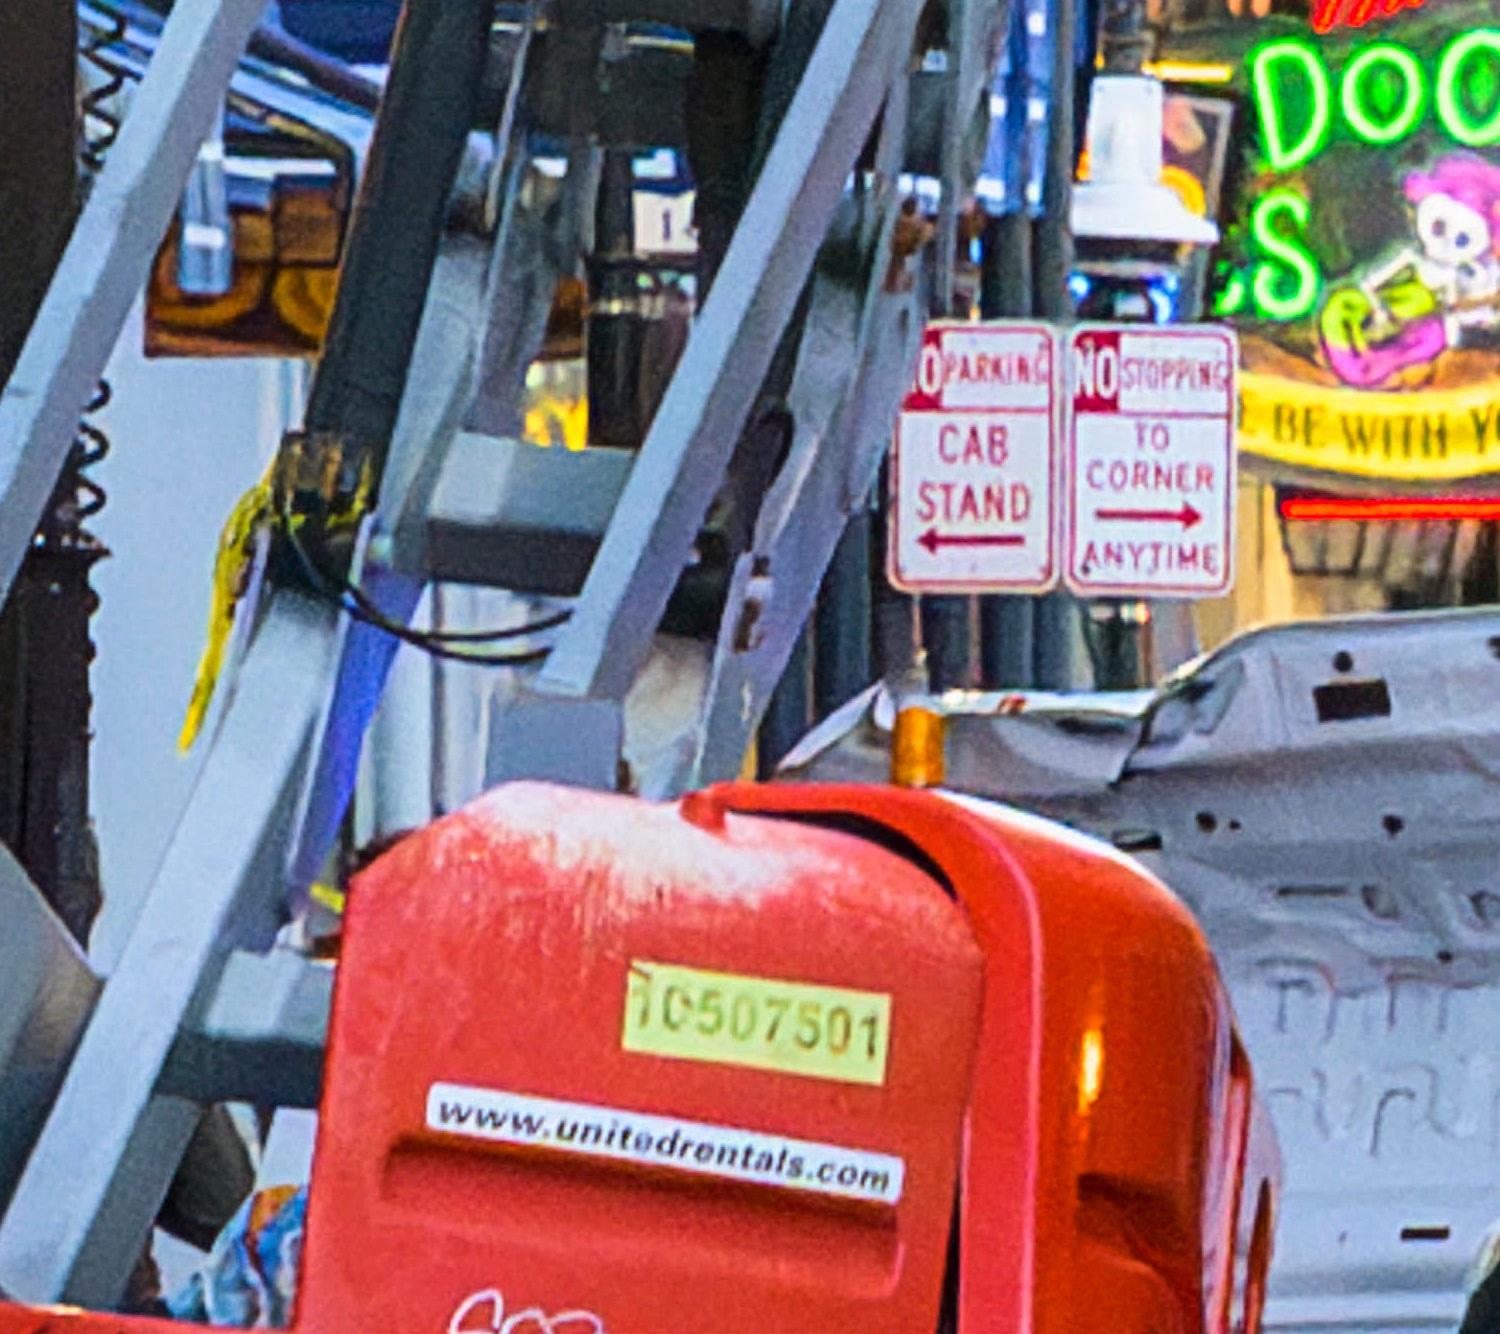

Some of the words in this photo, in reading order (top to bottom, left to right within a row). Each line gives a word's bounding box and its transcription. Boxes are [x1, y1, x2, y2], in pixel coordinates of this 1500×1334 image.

[913, 346, 942, 395] O
[945, 352, 1049, 385] PARKING
[1074, 343, 1118, 399] NO
[1120, 356, 1228, 391] STOPPING
[938, 424, 1009, 466] CAB
[1134, 424, 1170, 451] TO
[1273, 402, 1326, 448] BE
[1341, 411, 1448, 459] WITH
[1085, 461, 1214, 493] CORNER
[917, 481, 1032, 523] STAND
[1082, 540, 1218, 576] ANYTIME
[631, 979, 880, 1061] 10507501
[437, 1098, 891, 1195] www.unitedrentals.com
